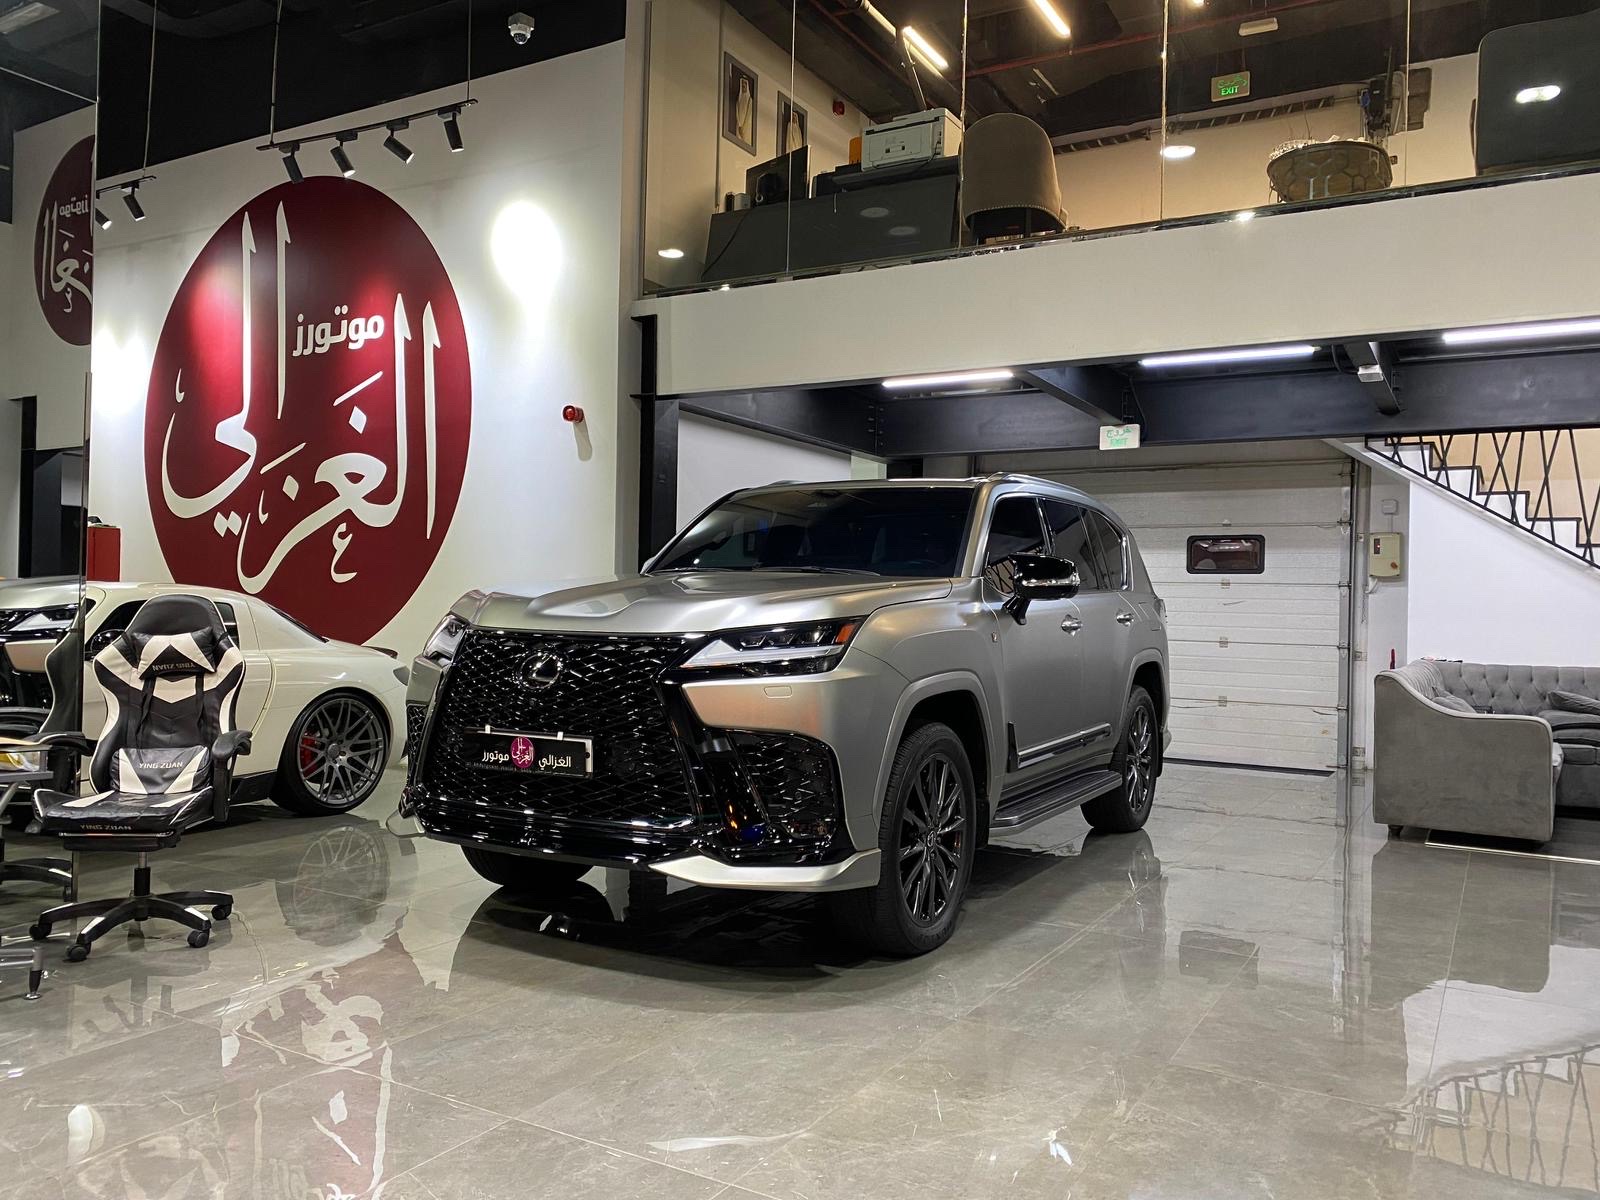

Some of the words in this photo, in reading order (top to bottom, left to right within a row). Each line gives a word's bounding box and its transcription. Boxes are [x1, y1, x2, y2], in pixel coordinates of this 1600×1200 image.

[1221, 86, 1239, 95] EXIT
[292, 304, 385, 357] موتورز
[482, 749, 510, 763] موتورز
[538, 754, 572, 770] الغزالي
[160, 761, 183, 769] ZUAN
